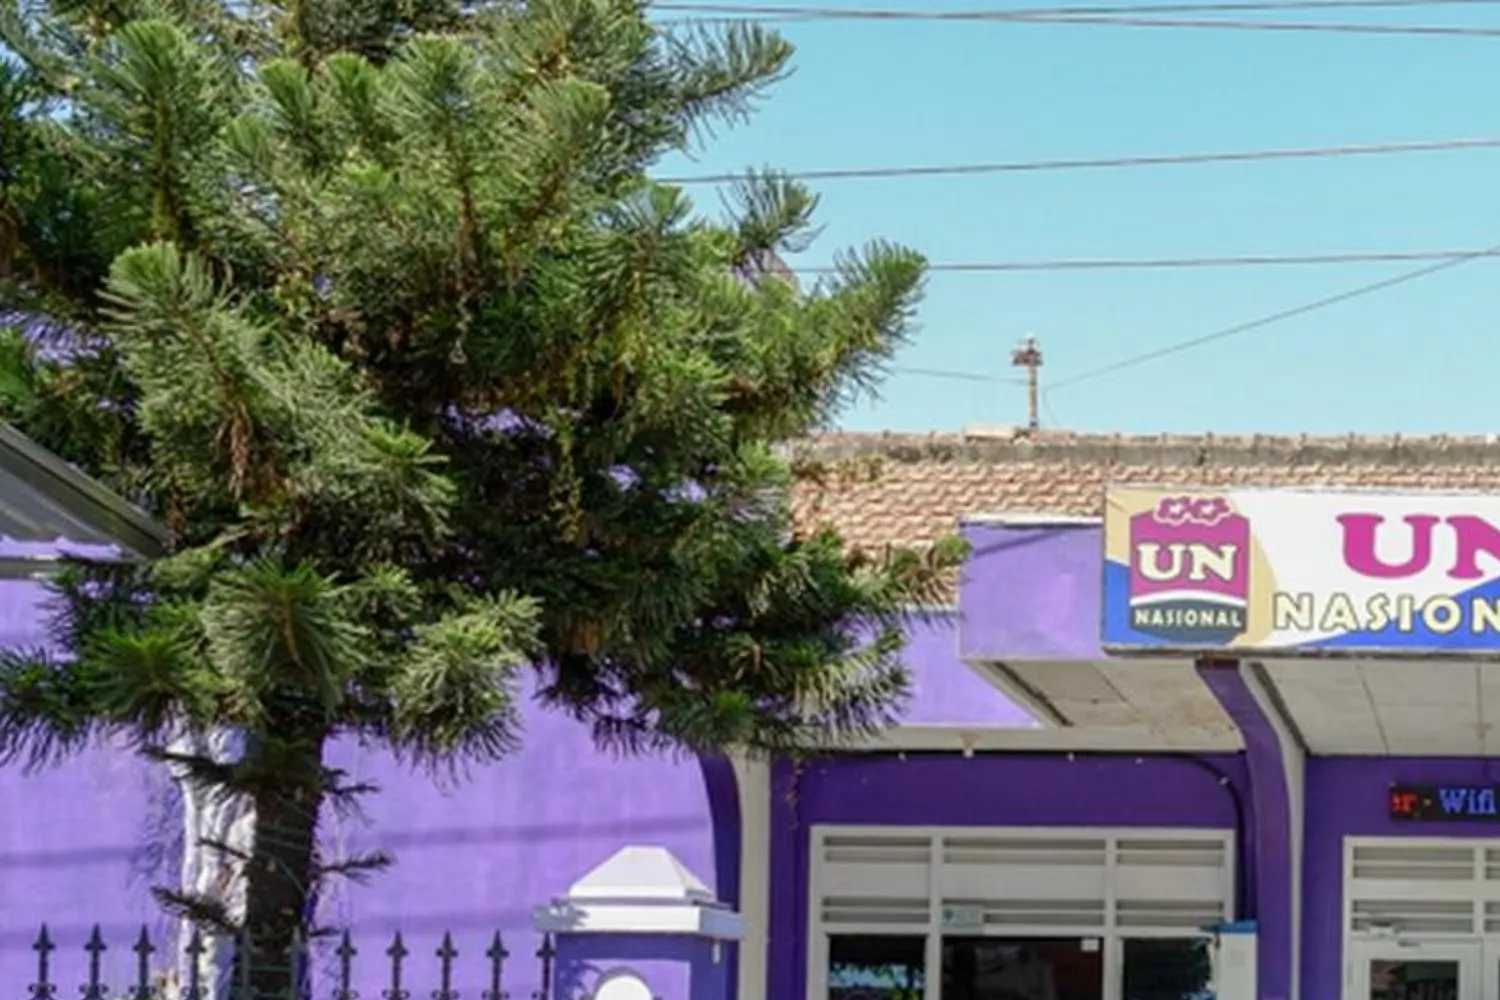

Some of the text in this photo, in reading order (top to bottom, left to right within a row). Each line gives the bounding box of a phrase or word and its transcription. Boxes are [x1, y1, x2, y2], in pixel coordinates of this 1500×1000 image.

[1137, 542, 1237, 582] UN
[1134, 608, 1242, 627] NASIONAL
[1438, 787, 1496, 815] Wifi
